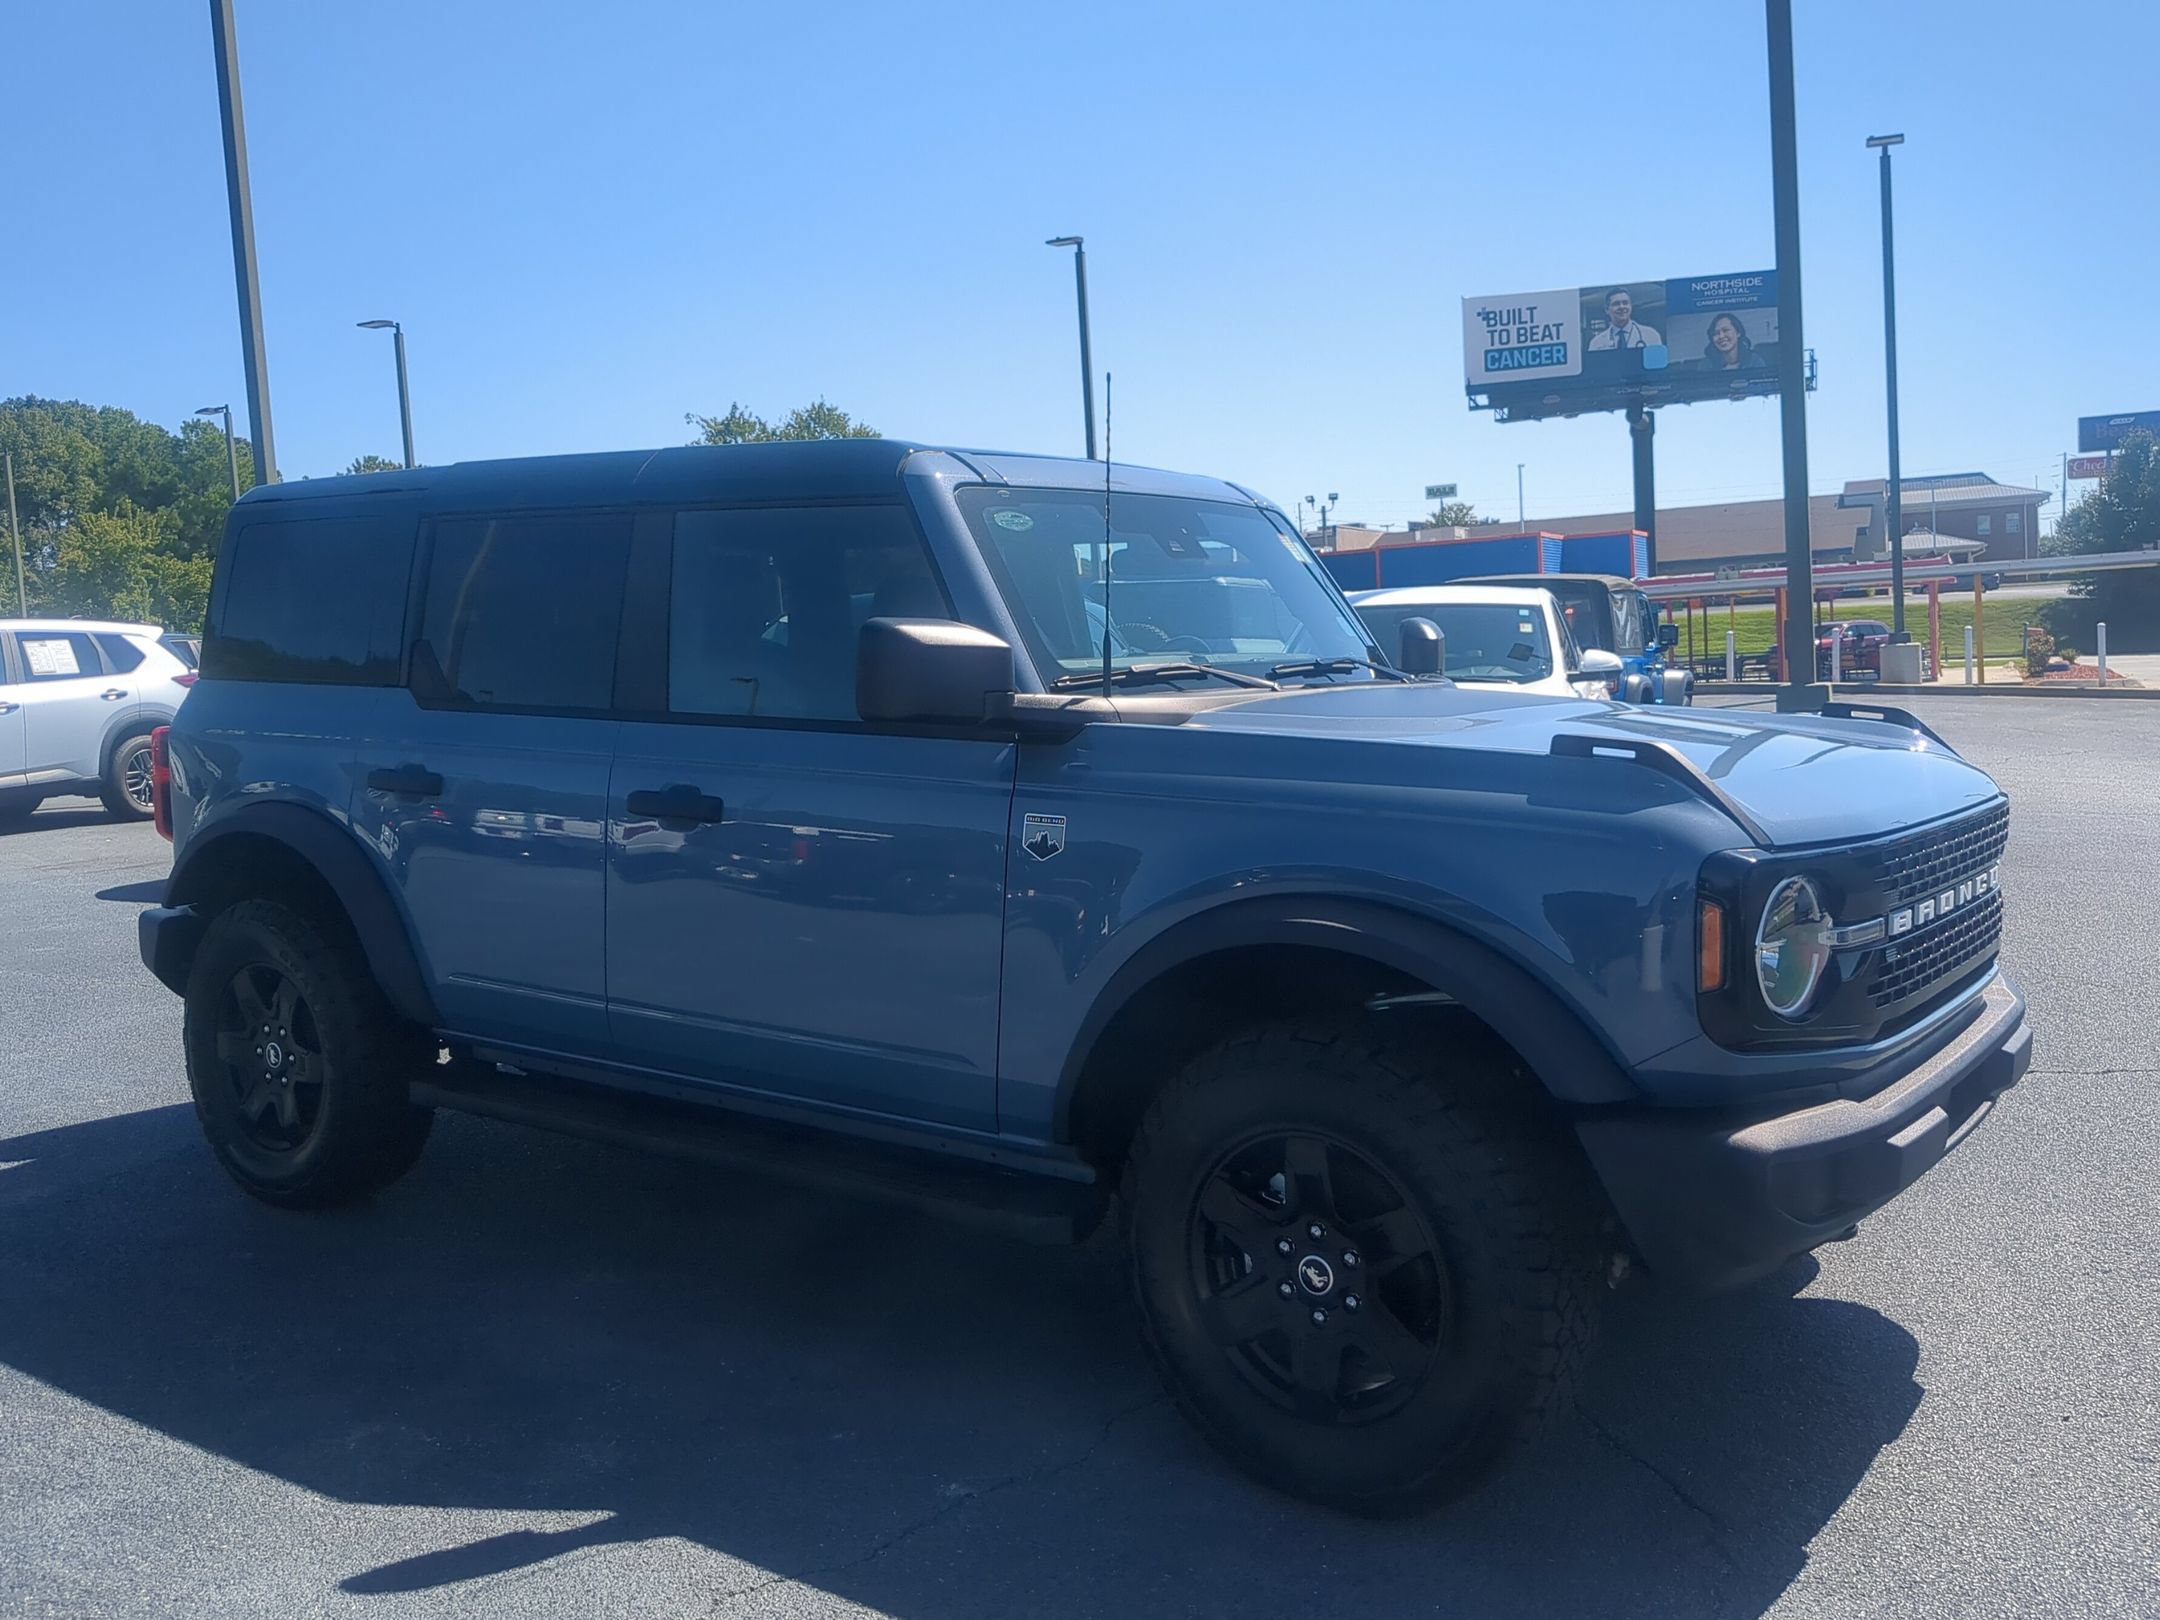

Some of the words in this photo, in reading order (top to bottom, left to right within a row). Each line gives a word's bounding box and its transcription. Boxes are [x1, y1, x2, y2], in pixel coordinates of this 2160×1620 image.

[1691, 276, 1763, 291] NORTHSIDE
[1704, 287, 1749, 296] HOSPITAL
[1725, 296, 1758, 304] INSTITUTE
[1485, 306, 1538, 328] BUILT
[1486, 328, 1511, 347] TO
[1516, 322, 1564, 345] BEAT
[1486, 345, 1566, 371] CANCER
[1888, 865, 2000, 936] BRONCO
